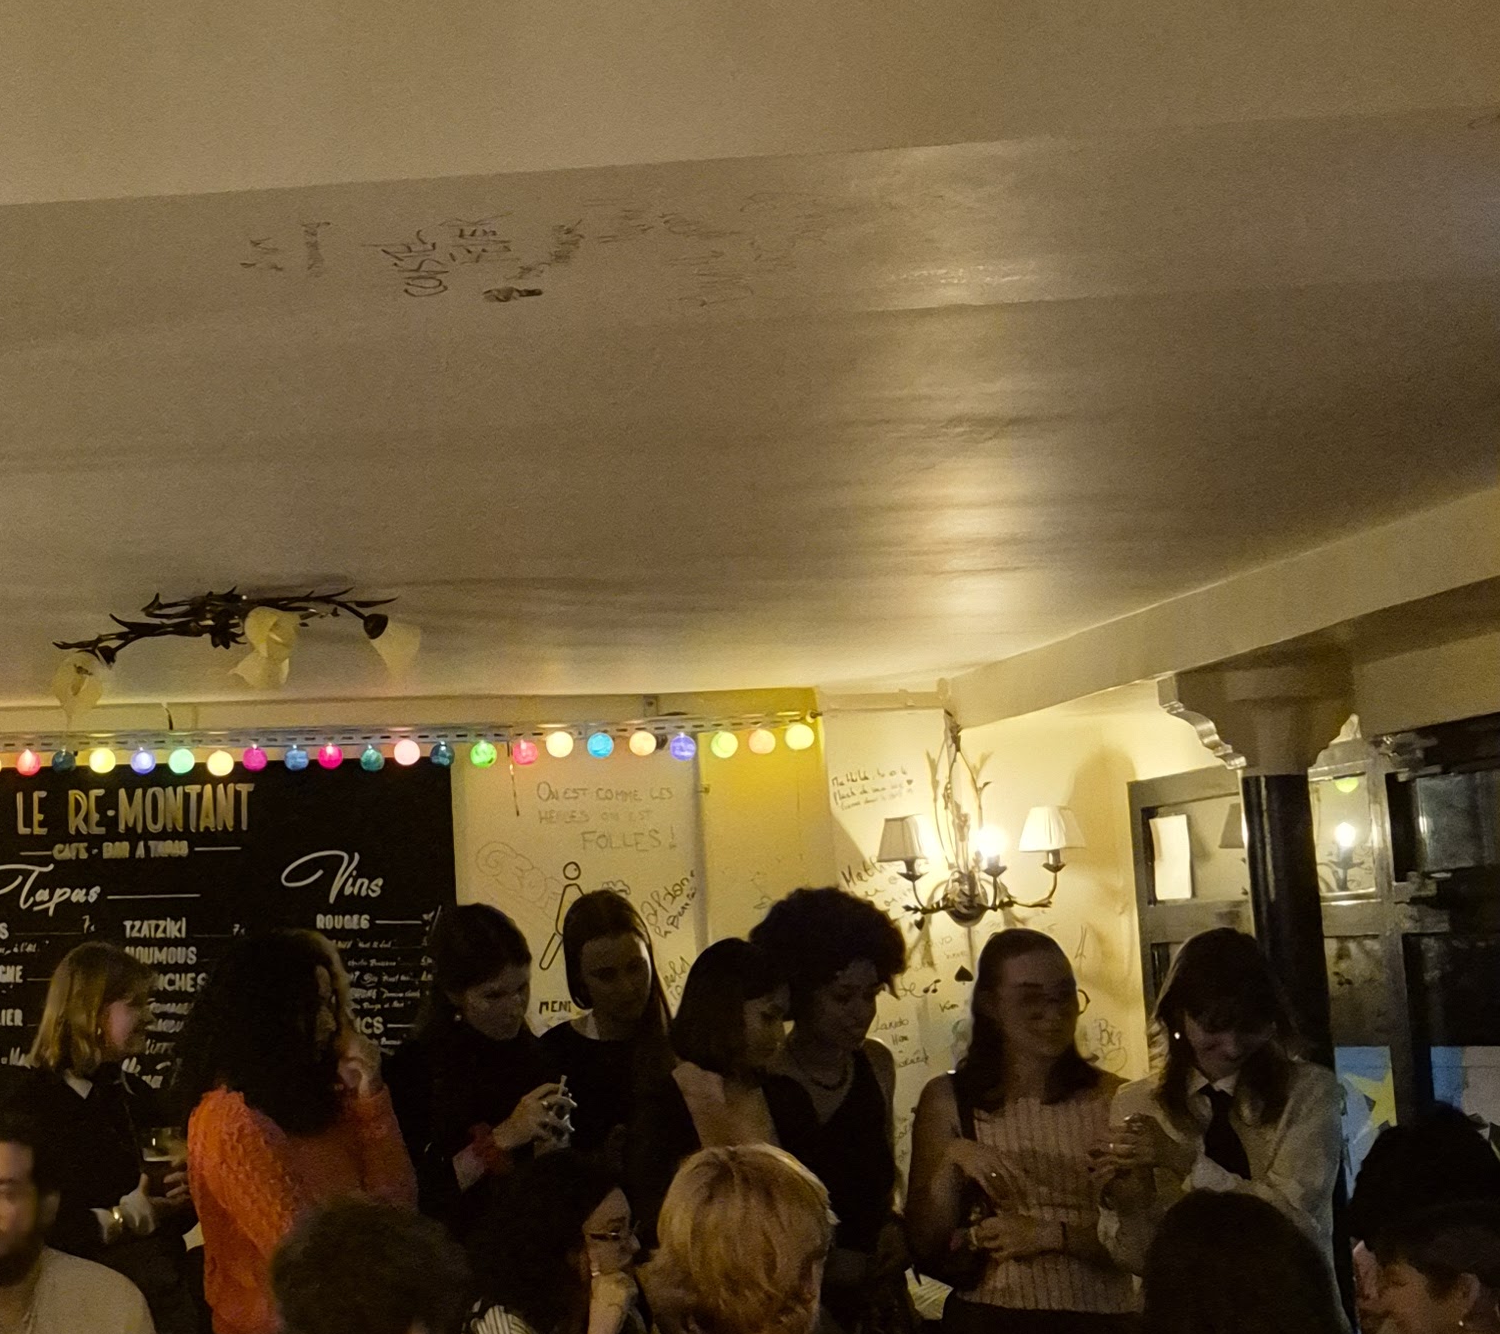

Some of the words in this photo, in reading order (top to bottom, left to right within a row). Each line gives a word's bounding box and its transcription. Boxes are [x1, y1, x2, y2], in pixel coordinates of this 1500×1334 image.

[595, 787, 643, 802] COMME
[16, 790, 48, 835] LE
[67, 783, 255, 835] RE-MONTANT
[580, 828, 662, 852] FOLLES
[281, 849, 384, 905] Vins
[315, 913, 371, 930] ROUGES
